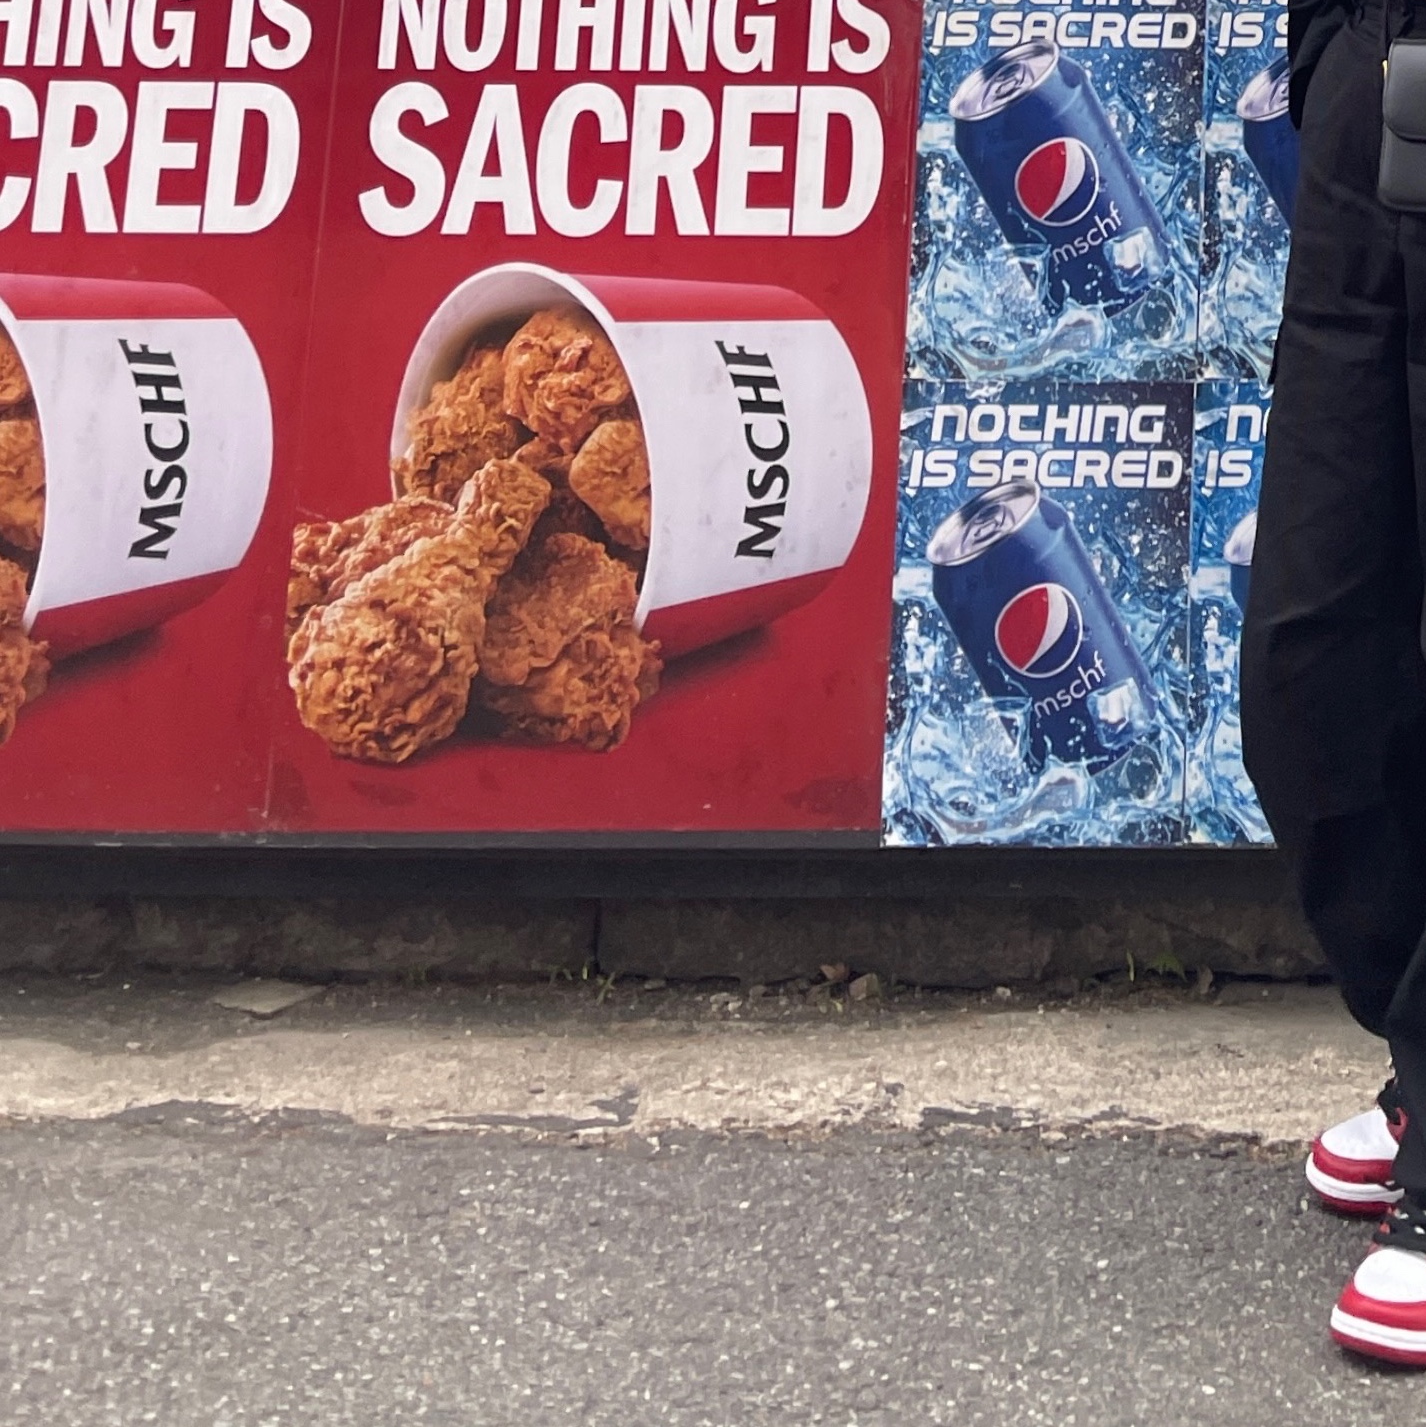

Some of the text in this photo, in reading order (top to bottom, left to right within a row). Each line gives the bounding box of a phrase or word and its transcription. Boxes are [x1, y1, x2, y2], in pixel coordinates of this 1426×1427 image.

[932, 11, 1198, 49] IS SACRED
[1218, 11, 1265, 48] IS
[358, 83, 885, 238] SACRED
[1052, 201, 1124, 267] mschf
[118, 338, 191, 561] MSCHF
[714, 339, 791, 560] MSCHF
[908, 448, 1185, 489] IS SACRED
[1205, 449, 1253, 489] IS
[1034, 650, 1108, 720] mschf
